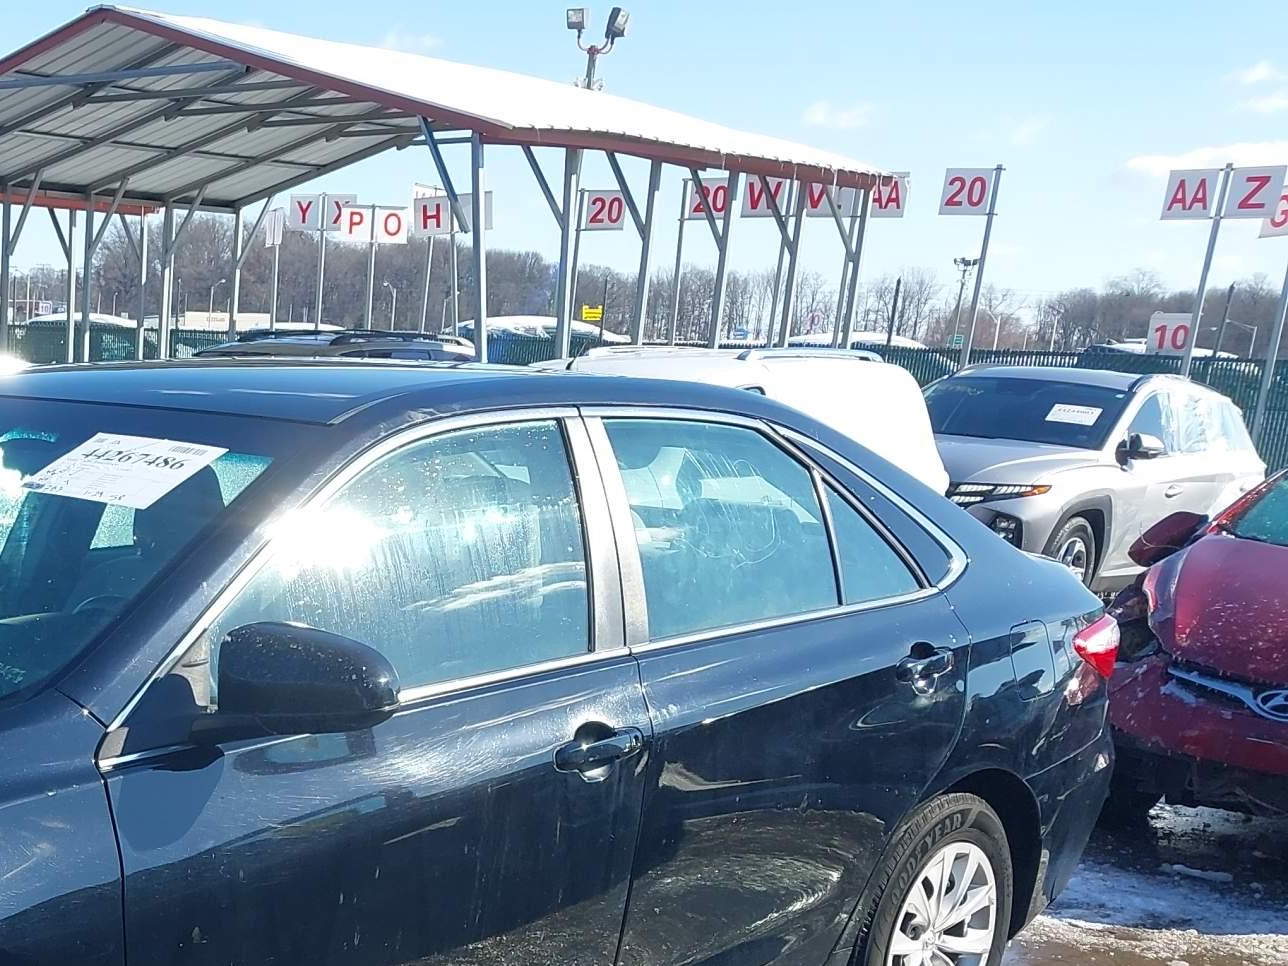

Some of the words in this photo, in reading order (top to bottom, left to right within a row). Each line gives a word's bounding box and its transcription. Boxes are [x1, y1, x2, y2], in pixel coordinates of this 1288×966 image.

[692, 185, 729, 213] 20
[944, 176, 987, 207] 20
[1167, 178, 1208, 211] AA
[1238, 176, 1272, 209] Z
[296, 200, 314, 225] Y
[348, 211, 364, 235] P
[422, 203, 441, 230] H
[589, 196, 624, 224] 20
[1154, 324, 1190, 350] 10
[81, 447, 188, 470] 44267486
